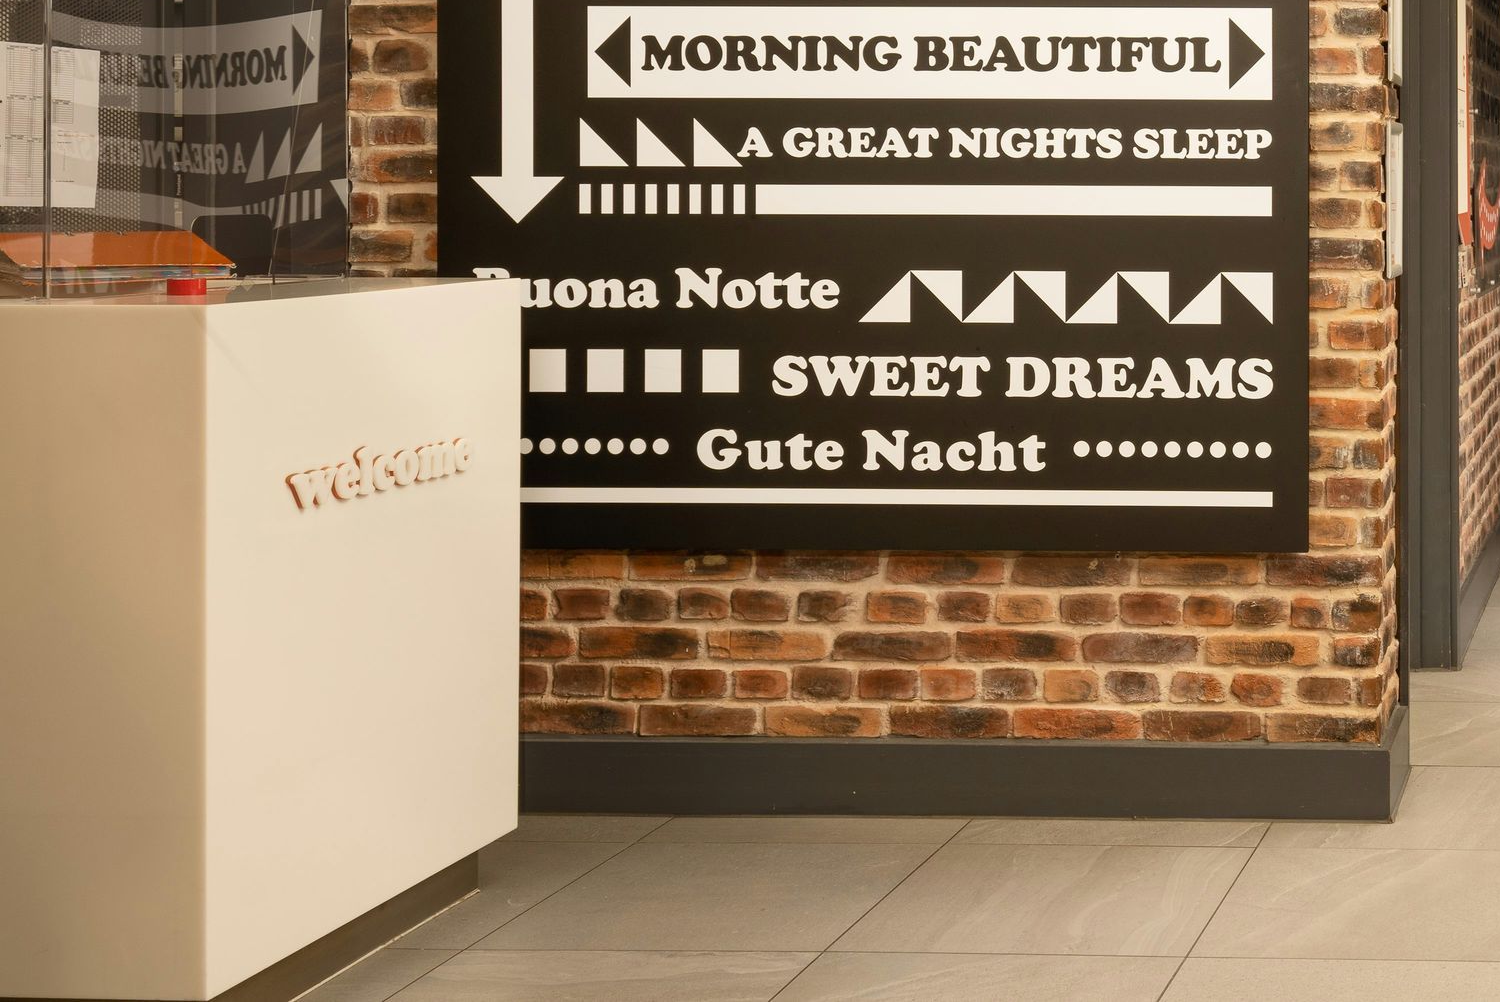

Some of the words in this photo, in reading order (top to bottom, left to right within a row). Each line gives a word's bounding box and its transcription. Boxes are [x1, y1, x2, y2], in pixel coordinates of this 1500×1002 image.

[641, 34, 903, 72] MORNING
[913, 35, 1222, 73] BEAUTIFUL
[737, 126, 774, 158] A
[783, 126, 939, 159] GREAT
[948, 127, 1123, 160] NIGHTS
[1132, 127, 1273, 160] SLEEP
[675, 267, 841, 310] Notte
[771, 354, 991, 398] SWEET
[1004, 356, 1274, 400] DREAMS
[696, 428, 845, 471] Gute
[861, 429, 1047, 472] Nacht
[285, 437, 474, 513] welcome
